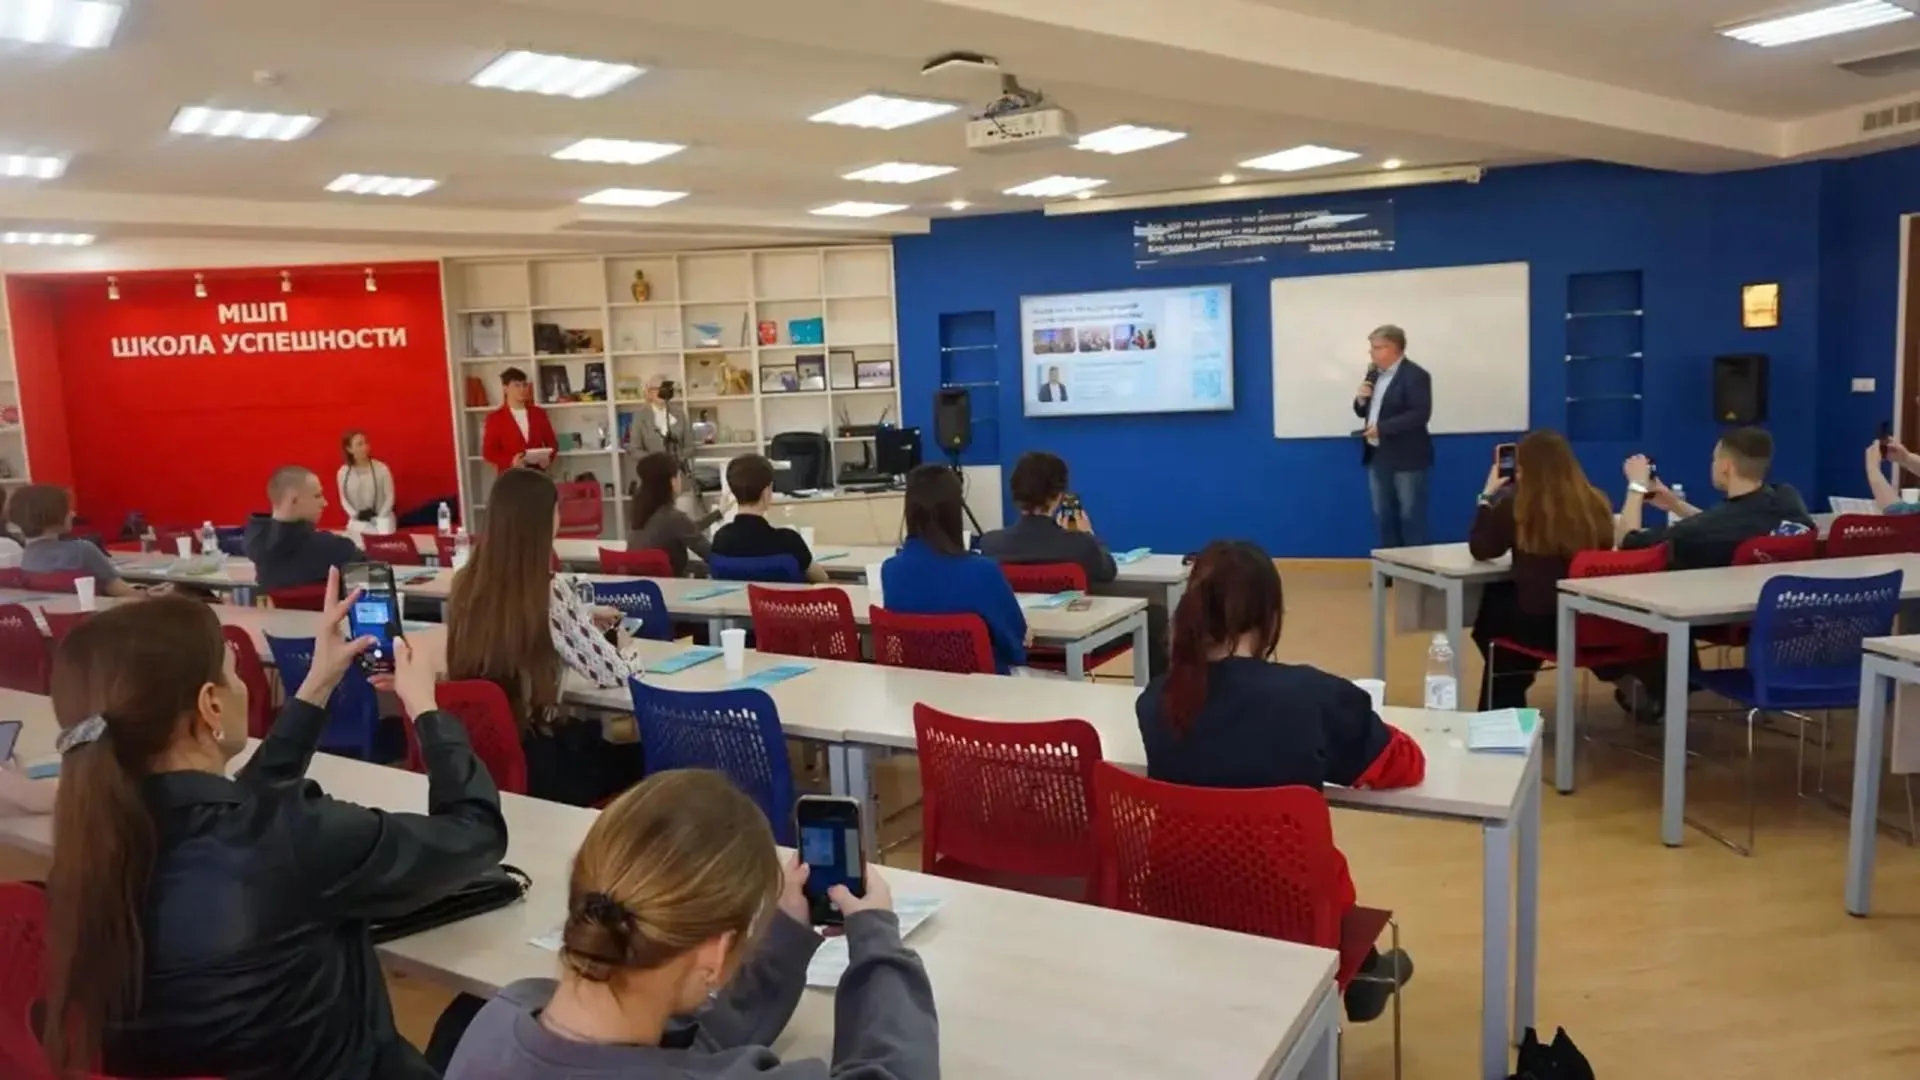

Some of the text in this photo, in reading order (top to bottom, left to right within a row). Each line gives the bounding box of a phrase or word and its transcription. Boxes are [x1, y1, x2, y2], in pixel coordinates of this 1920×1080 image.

[217, 302, 288, 324] МШП
[111, 327, 407, 357] ШКОЛА УСПЕШНОСТИ
